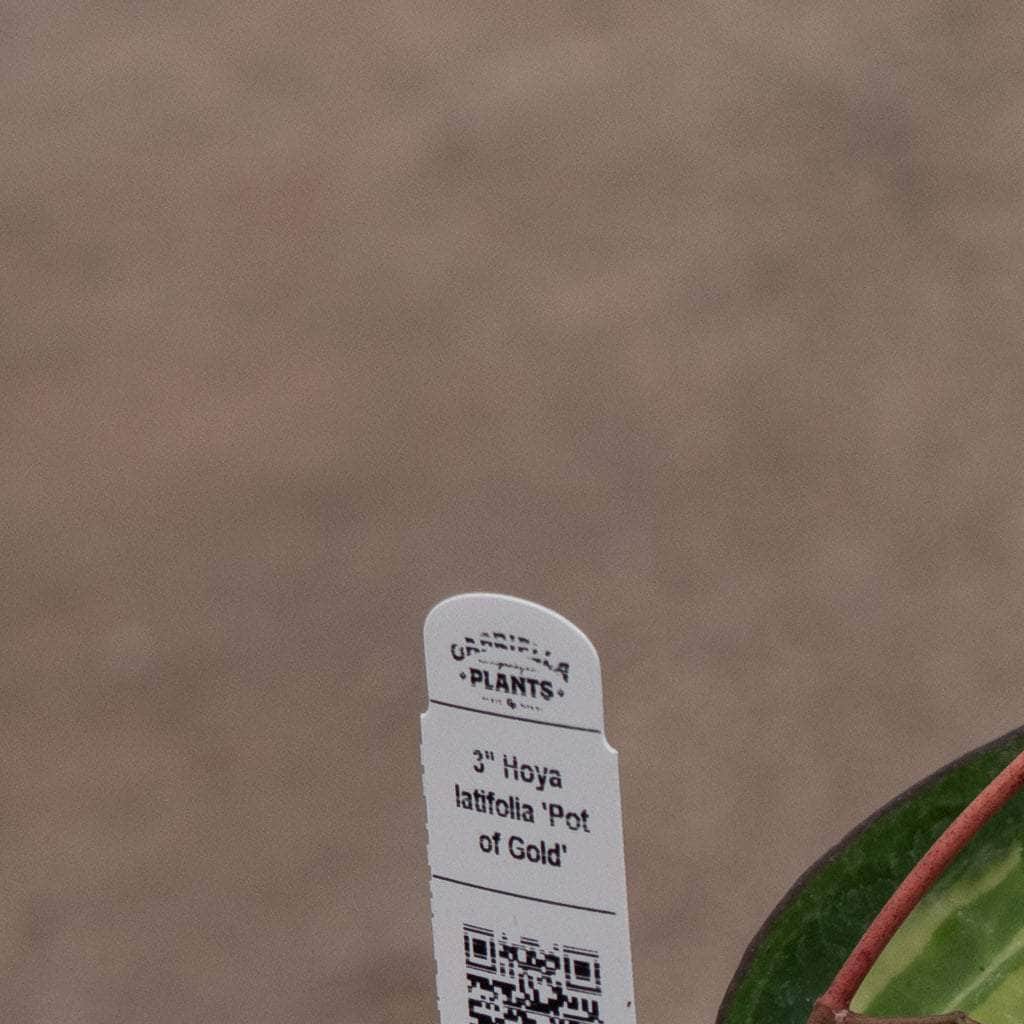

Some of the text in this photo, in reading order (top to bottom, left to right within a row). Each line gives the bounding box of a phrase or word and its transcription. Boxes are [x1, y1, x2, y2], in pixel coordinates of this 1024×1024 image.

[469, 667, 554, 701] PLANTS
[503, 754, 563, 791] Hoya
[455, 784, 591, 833] latifolia 'Pot
[479, 832, 567, 867] of Gold'
